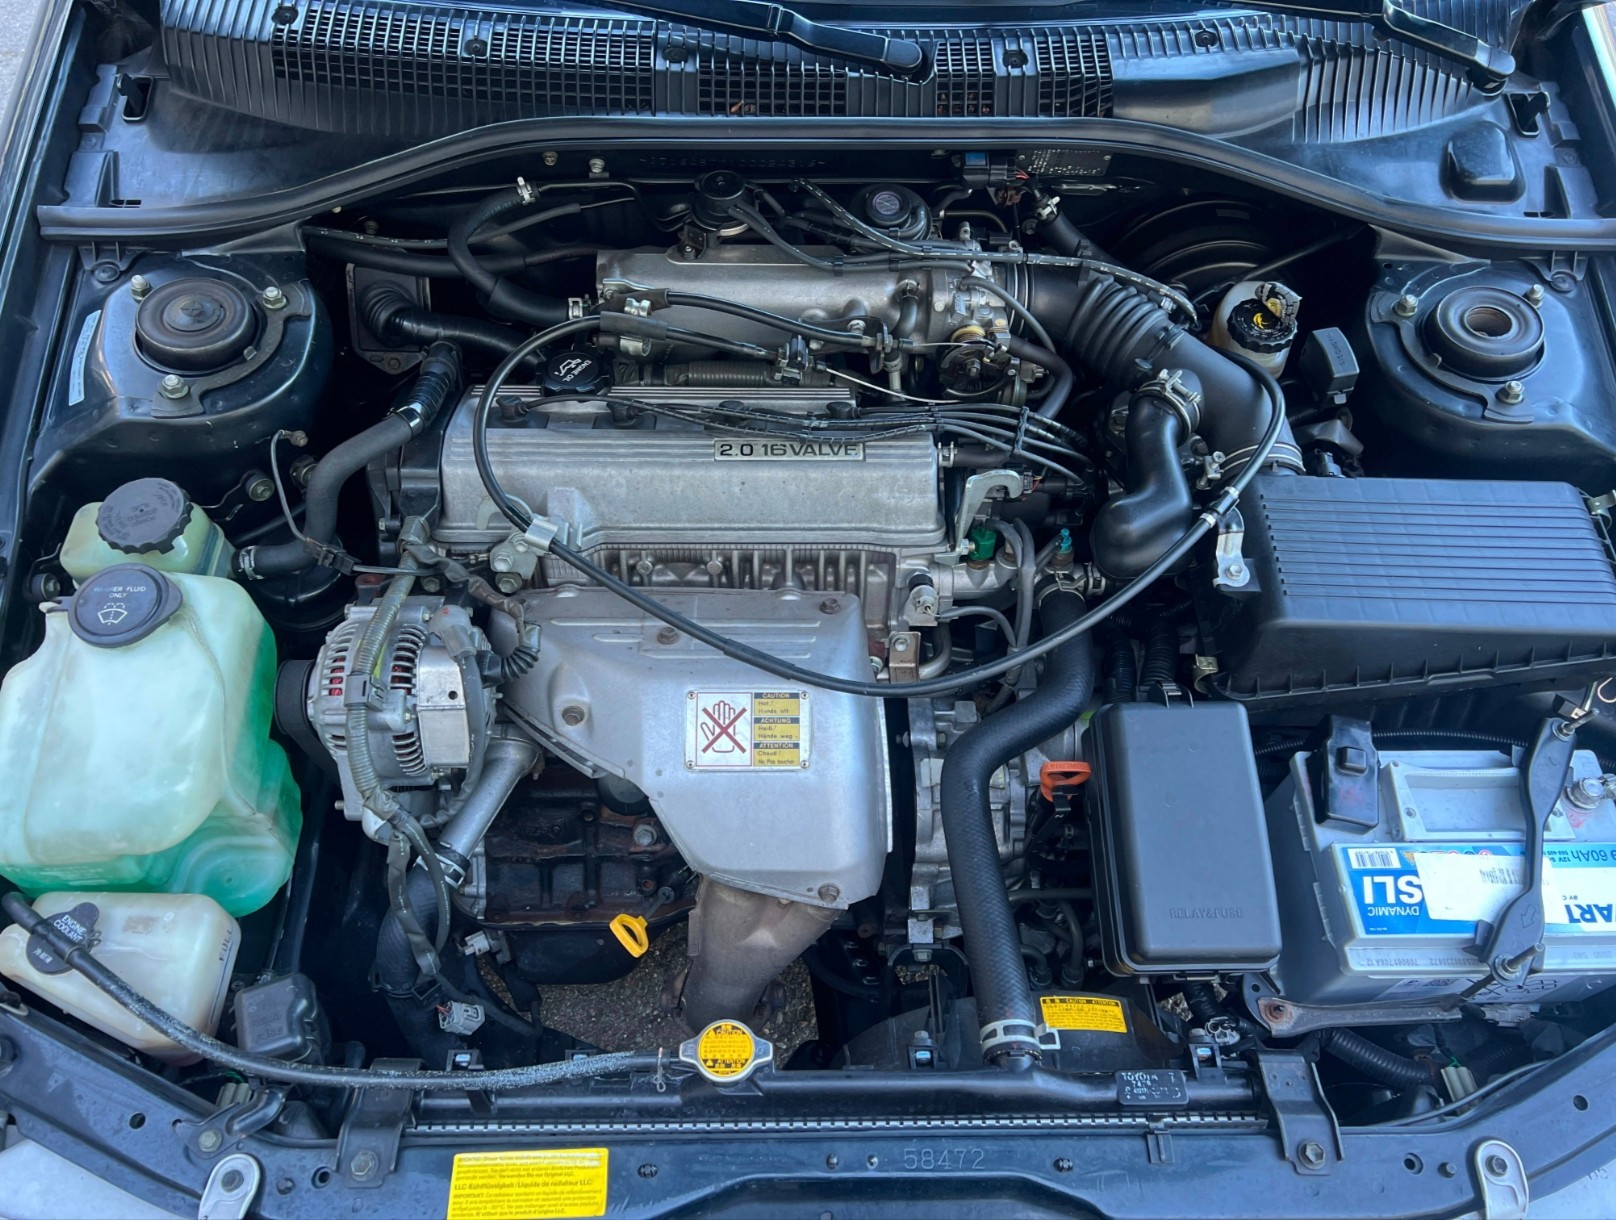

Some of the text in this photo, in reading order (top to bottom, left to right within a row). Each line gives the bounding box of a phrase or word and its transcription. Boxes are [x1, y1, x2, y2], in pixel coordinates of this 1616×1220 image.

[561, 359, 592, 382] ENGINE OIL
[719, 443, 754, 457] 2.0
[1571, 850, 1608, 862] 60Ah
[1363, 875, 1422, 904] SLI
[1169, 907, 1244, 919] RELAY&FUSE
[1367, 905, 1420, 917] DYNAMIC
[53, 919, 84, 943] COOLANT
[61, 914, 87, 935] ENGINE
[219, 928, 233, 961] FULL
[1121, 1072, 1158, 1081] TOYOTA
[903, 1148, 985, 1170] 58472
